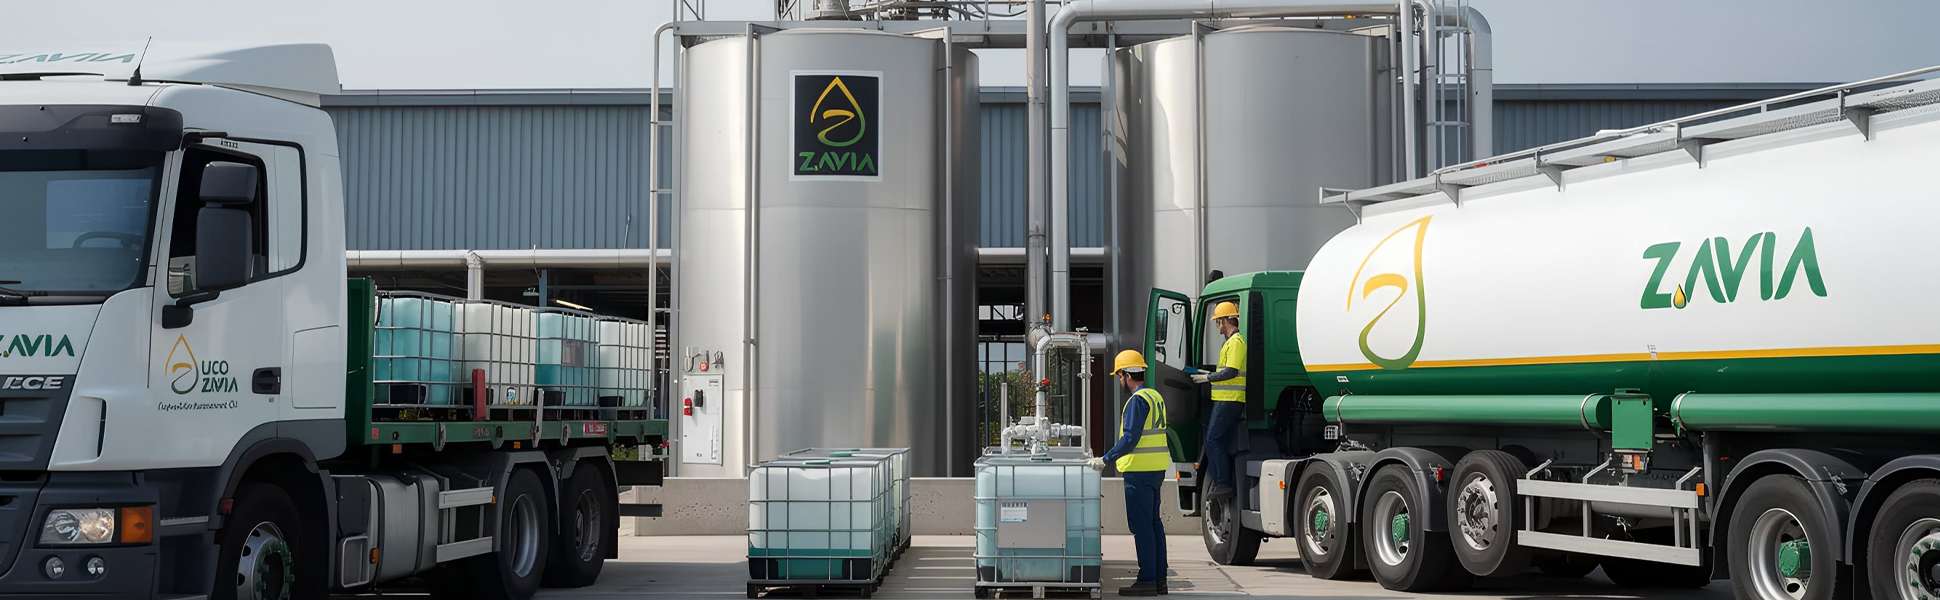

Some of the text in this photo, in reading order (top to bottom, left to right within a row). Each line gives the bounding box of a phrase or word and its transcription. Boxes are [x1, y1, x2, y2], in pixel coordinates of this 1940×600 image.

[799, 151, 876, 172] ZAVIA
[1640, 226, 1828, 309] ZAVIA
[0, 334, 75, 357] AVIA
[201, 360, 229, 375] UCO
